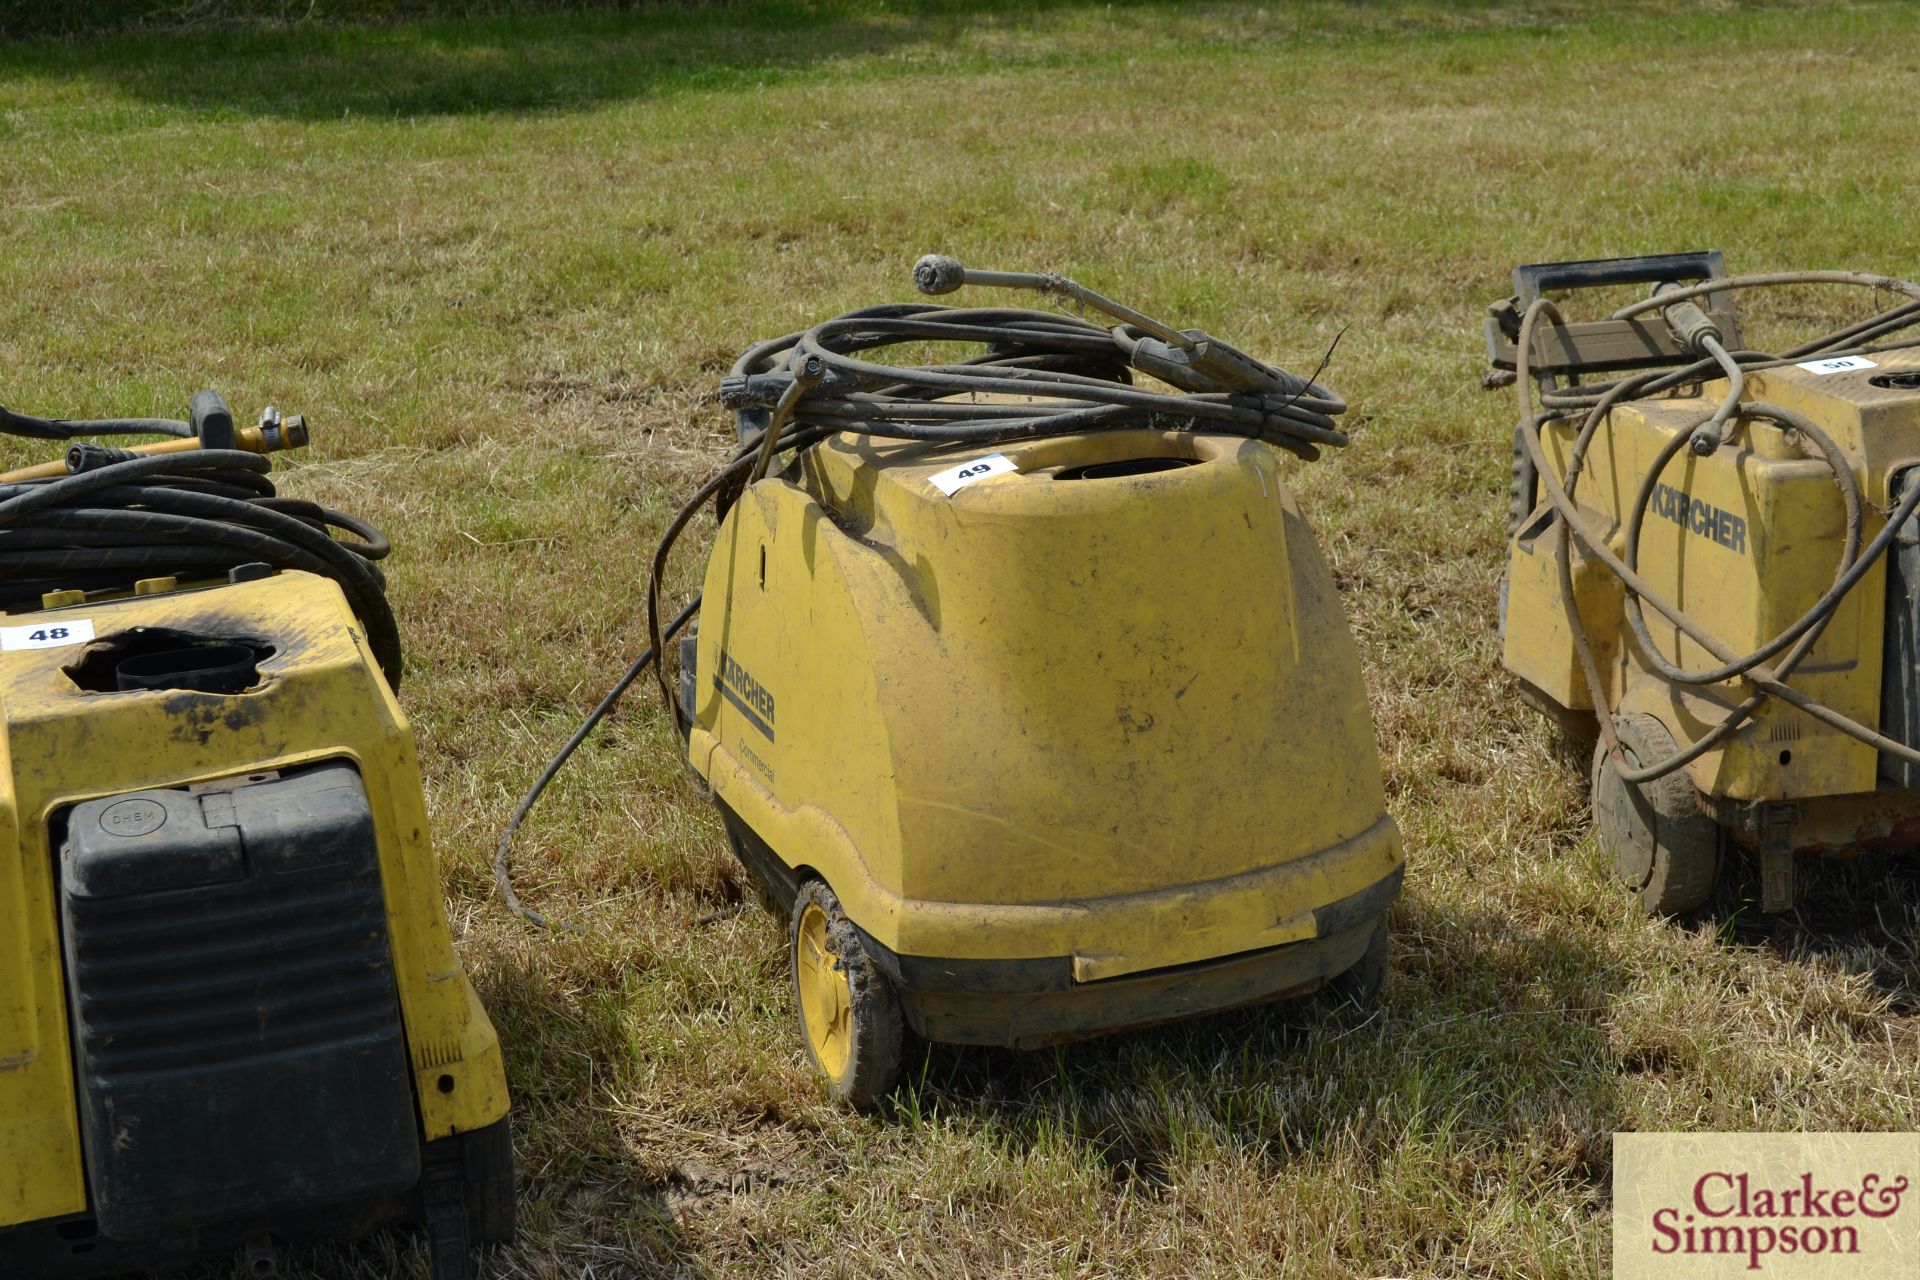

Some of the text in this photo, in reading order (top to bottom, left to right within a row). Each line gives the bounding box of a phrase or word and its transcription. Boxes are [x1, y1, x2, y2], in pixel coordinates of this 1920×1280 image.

[1822, 361, 1855, 369] 50
[958, 464, 992, 479] 49
[28, 627, 70, 641] 48
[739, 737, 775, 784] Commercial
[112, 812, 156, 824] CHEM
